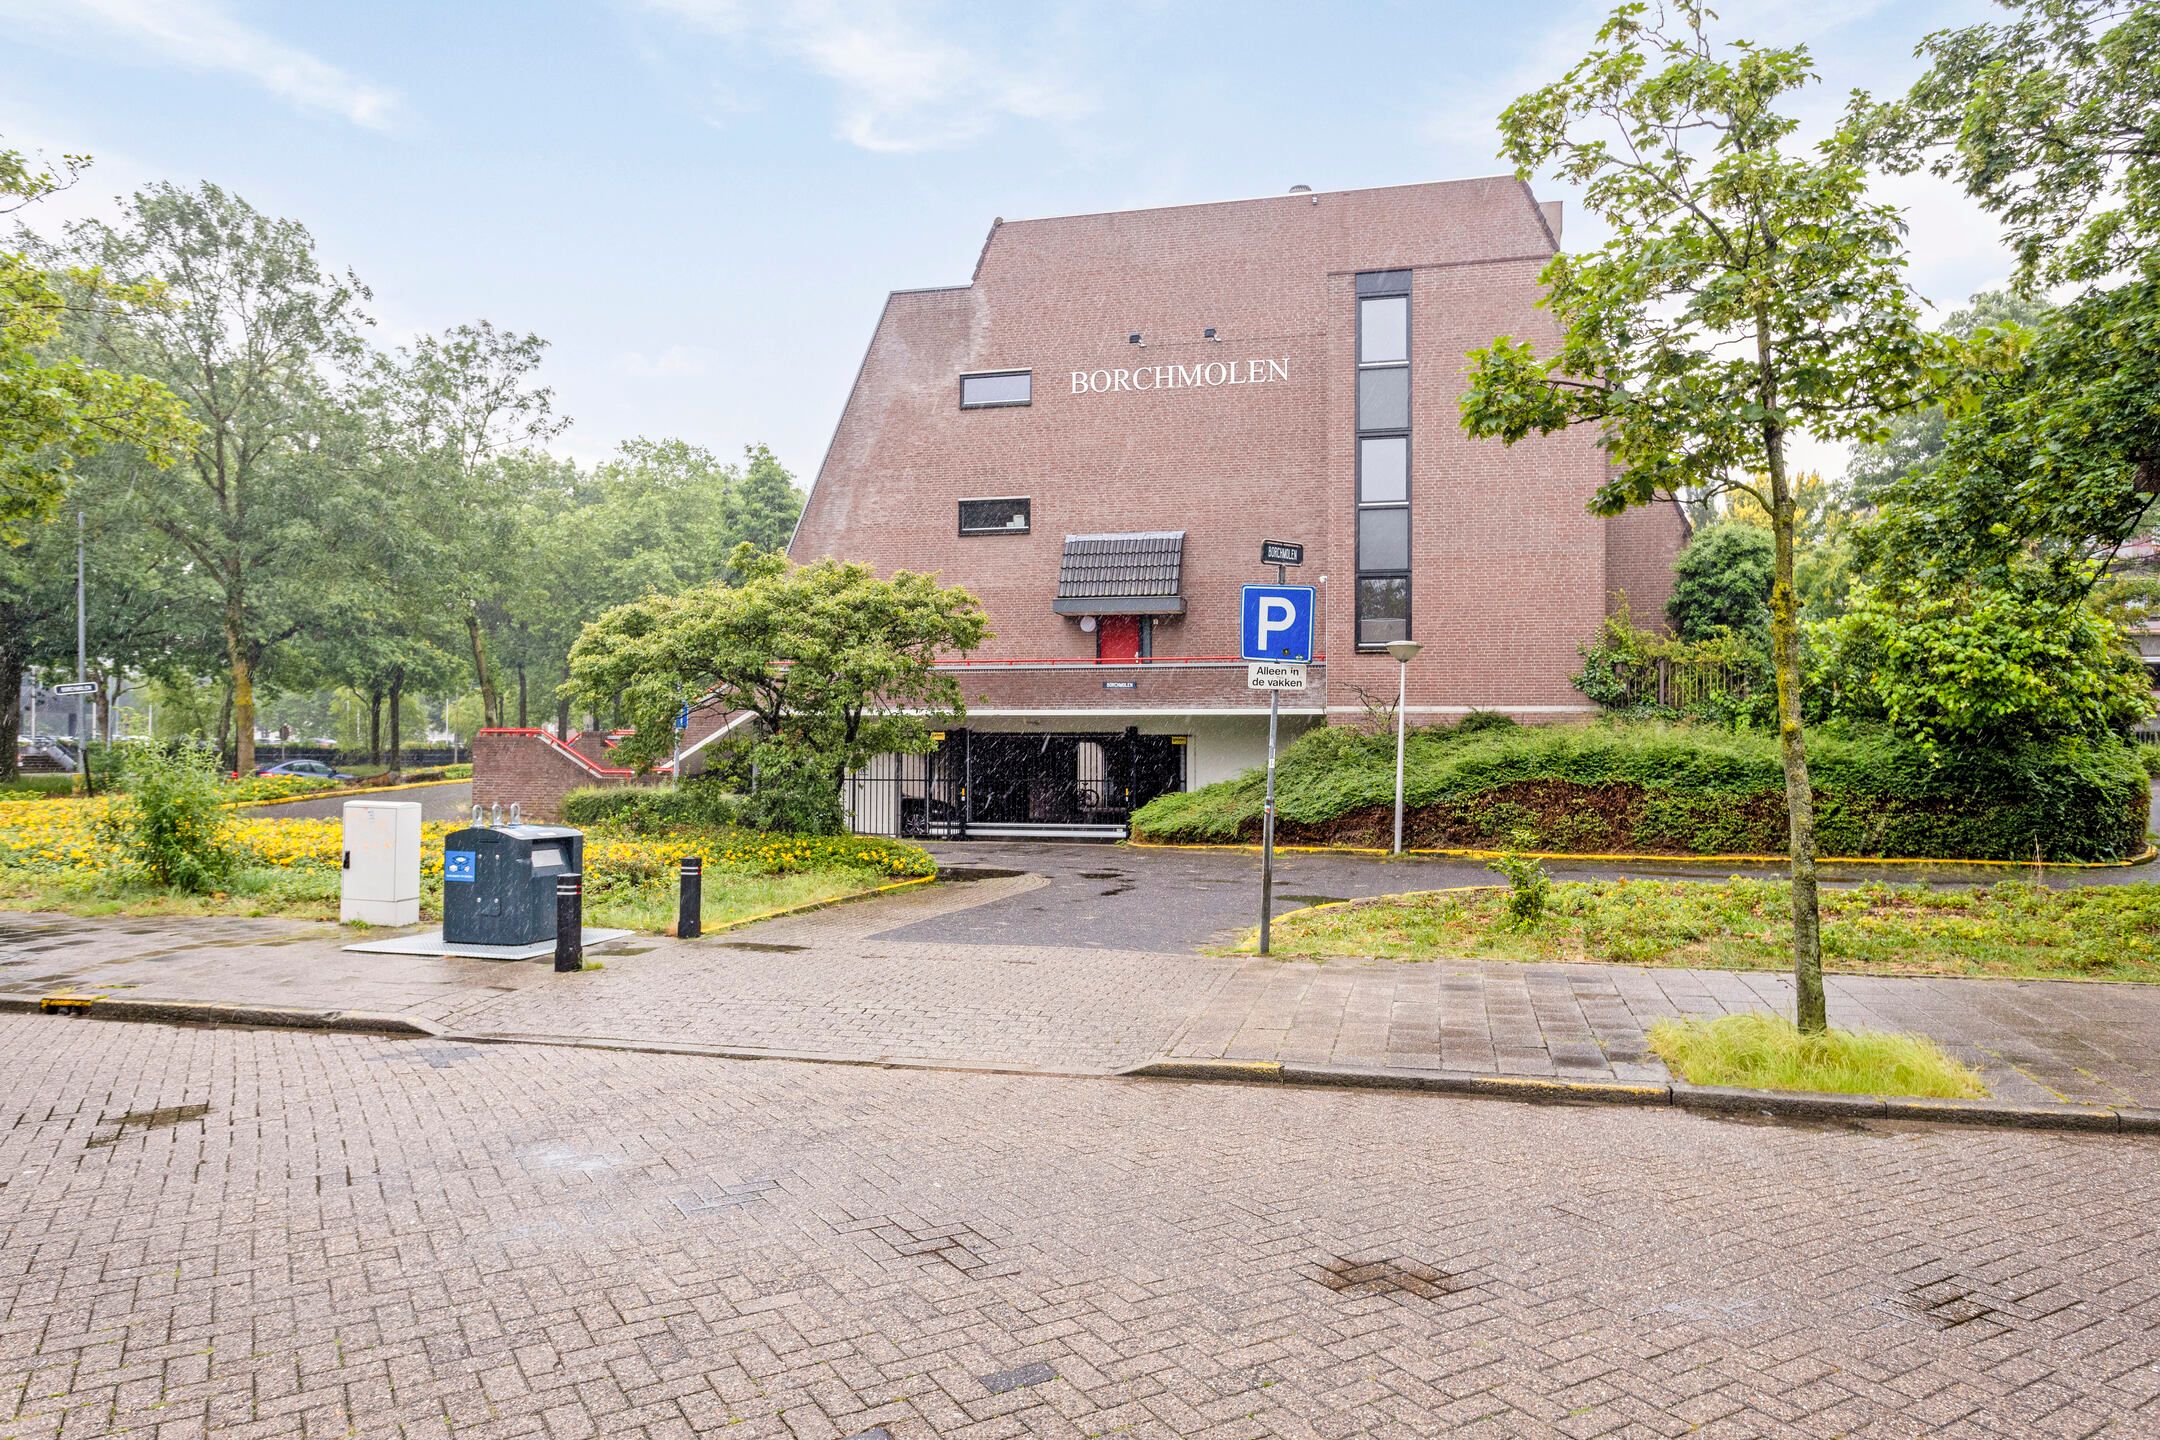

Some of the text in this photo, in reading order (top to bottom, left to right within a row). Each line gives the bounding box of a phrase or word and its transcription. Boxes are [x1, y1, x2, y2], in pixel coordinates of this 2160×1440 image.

[1071, 358, 1290, 394] BORCHMOLEN
[1268, 546, 1298, 560] BORCHMOLEN
[1257, 596, 1296, 651] P
[1256, 666, 1299, 676] Alleen in
[1252, 678, 1303, 688] de vakken
